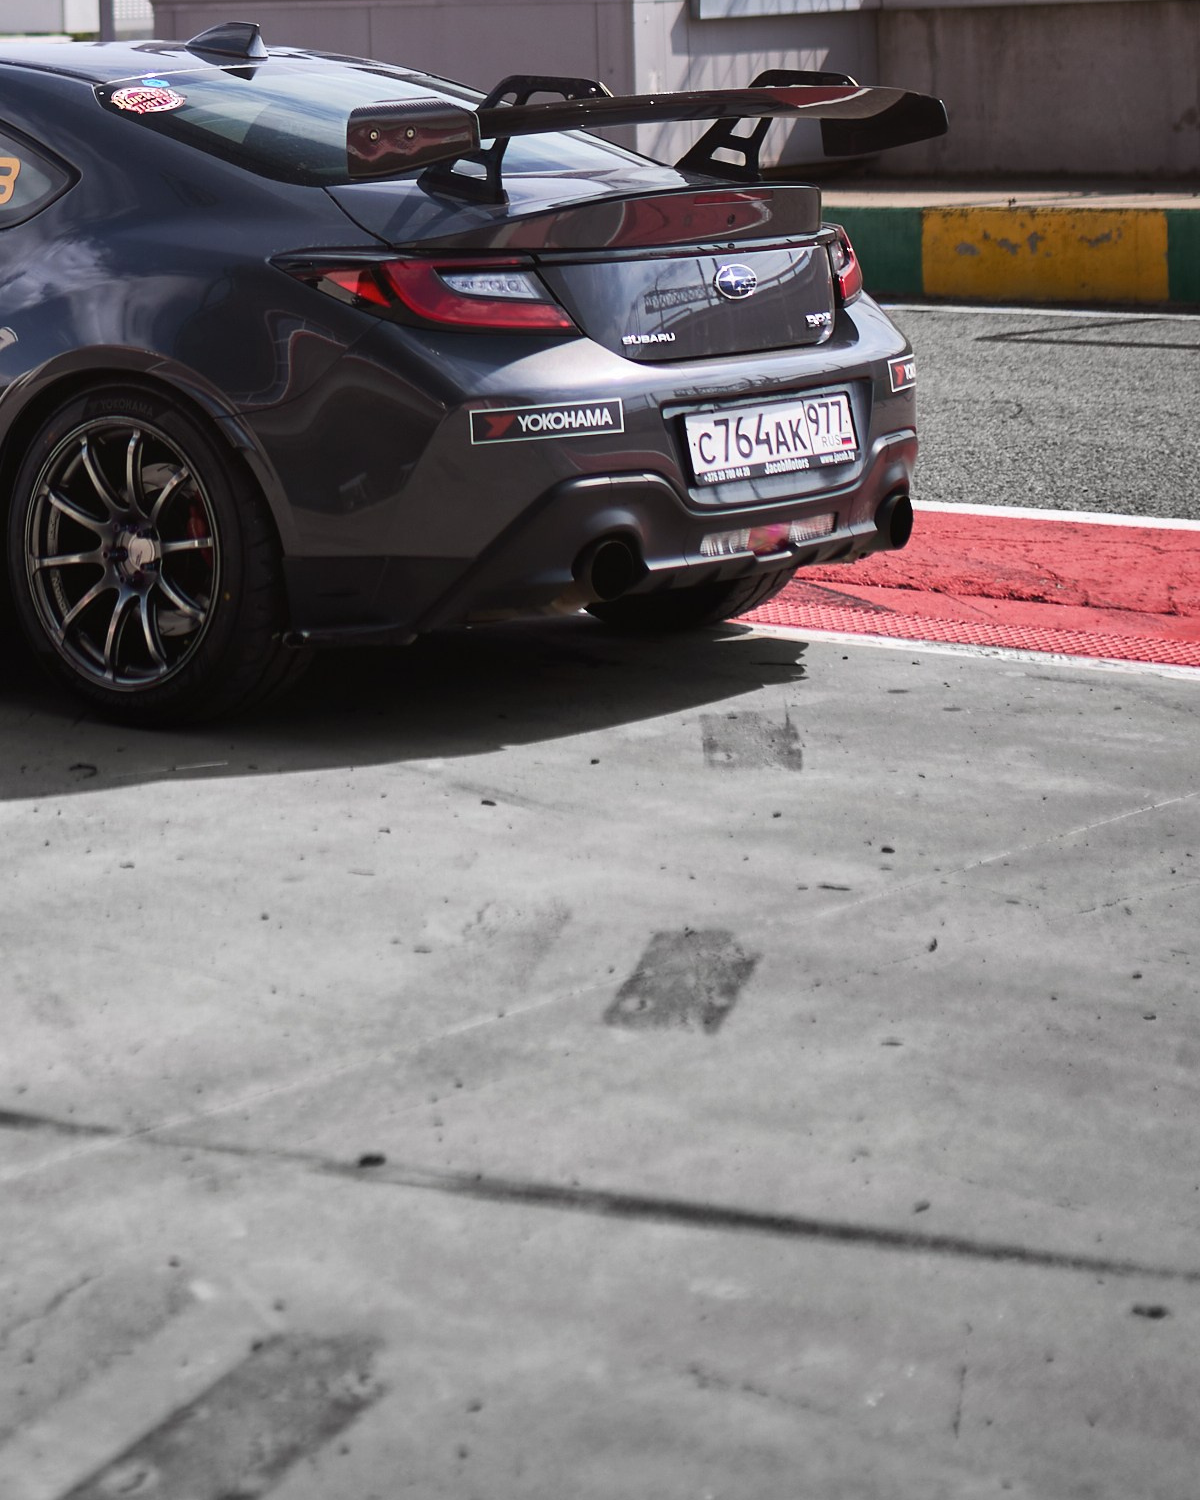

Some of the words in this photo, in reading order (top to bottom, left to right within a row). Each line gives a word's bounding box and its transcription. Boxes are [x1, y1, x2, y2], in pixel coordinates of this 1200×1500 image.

[622, 332, 676, 345] SUBARU
[517, 407, 613, 432] YOKOHAMA
[699, 413, 808, 465] C764AK
[807, 400, 842, 436] 977
[822, 435, 841, 447] RUS
[765, 457, 810, 475] JacobMotors
